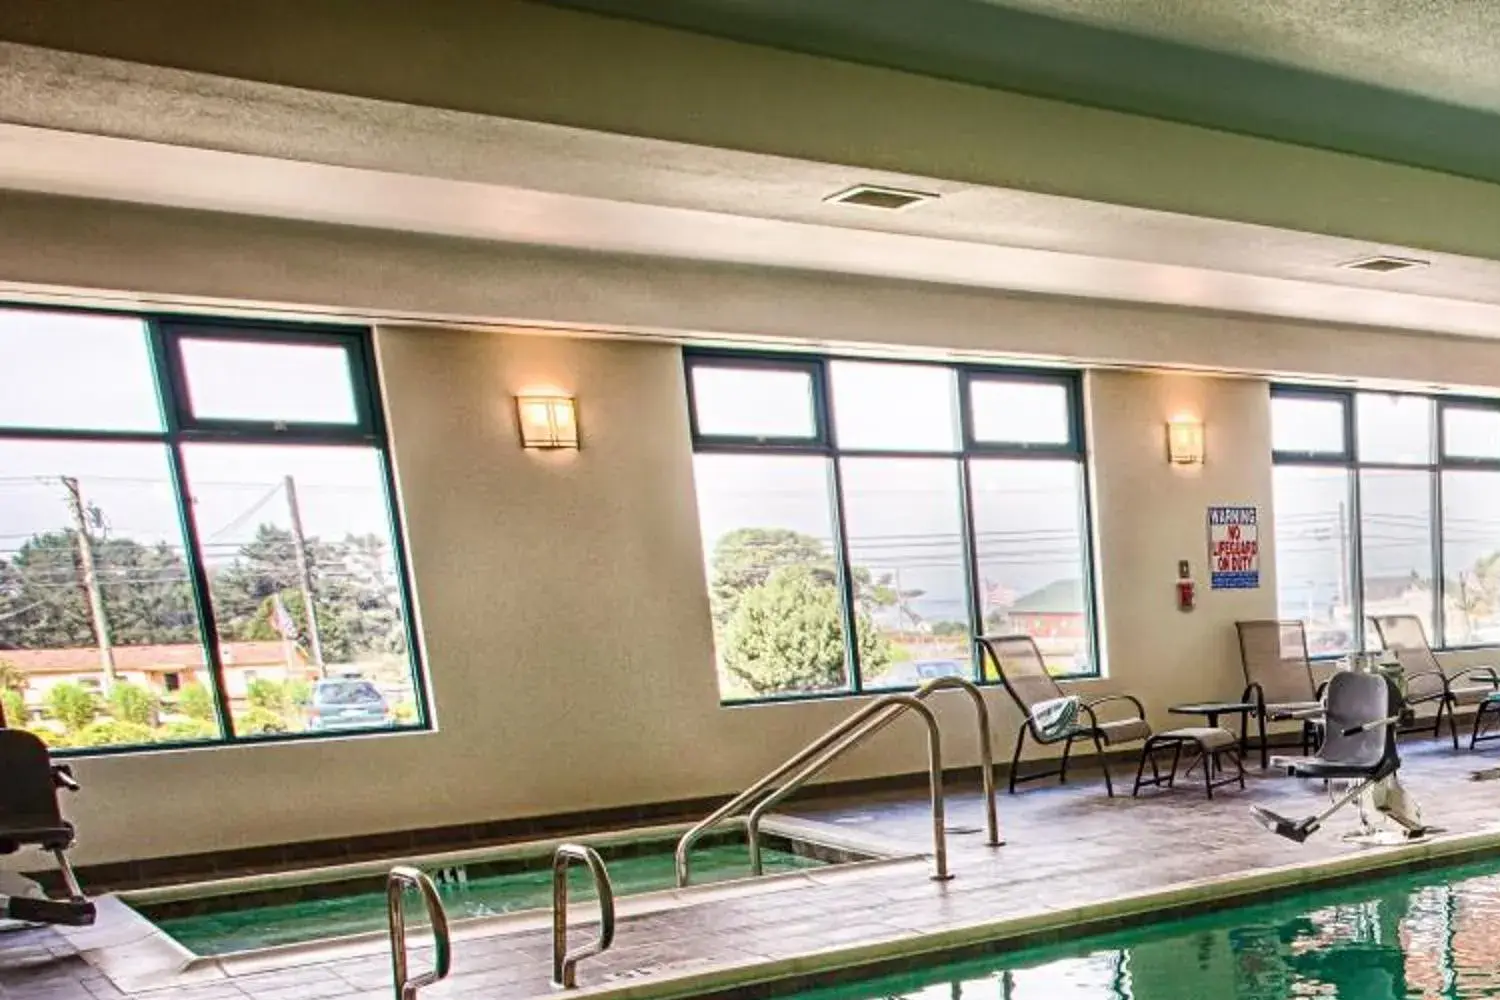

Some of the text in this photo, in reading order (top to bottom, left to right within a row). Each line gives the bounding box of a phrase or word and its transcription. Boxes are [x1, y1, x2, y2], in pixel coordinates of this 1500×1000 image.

[1210, 508, 1256, 525] WARNING
[1227, 525, 1240, 540] NO
[1213, 541, 1258, 556] LIFEGUARD
[1217, 557, 1252, 571] ON DUTY
